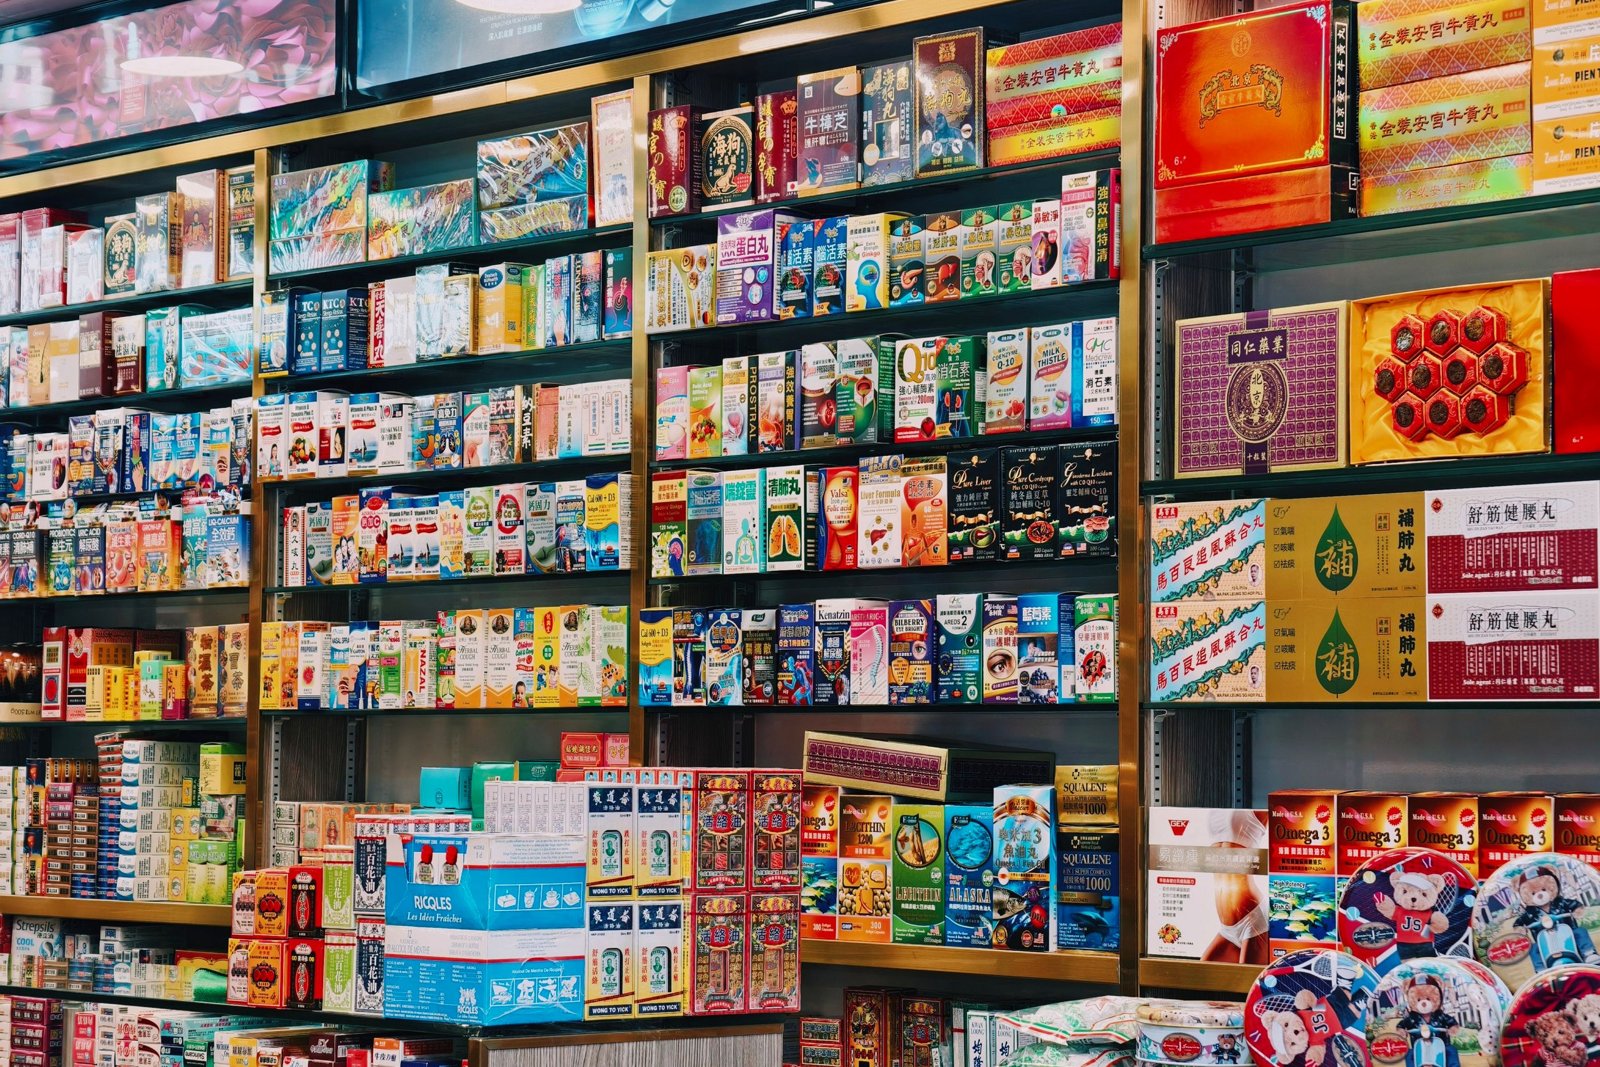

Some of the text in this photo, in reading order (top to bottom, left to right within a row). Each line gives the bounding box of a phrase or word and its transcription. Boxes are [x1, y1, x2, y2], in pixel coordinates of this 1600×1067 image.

[1379, 11, 1498, 49] 金裝安宮牛黃丸
[1003, 59, 1100, 92] 金裝安宮牛黃丸
[1379, 103, 1499, 139] 金裝安宮牛黃丸
[1042, 347, 1060, 358] MILK
[1231, 336, 1284, 357] 同仁藥業
[997, 357, 1015, 369] Q-10
[1037, 353, 1066, 368] THISTLE
[938, 361, 971, 379] 消石素
[1085, 376, 1112, 389] 消石素
[749, 366, 758, 441] PROSTRAL
[975, 476, 992, 486] Liver
[1468, 501, 1556, 525] 舒筋健腰丸
[1398, 508, 1416, 573] 補肺丸
[818, 609, 850, 620] Kenatzin
[894, 618, 925, 626] BILBERRY
[961, 616, 967, 625] 2
[1468, 610, 1557, 631] 舒筋健腰丸
[1398, 613, 1417, 678] 補肺丸
[419, 649, 427, 692] NAZAL
[1063, 782, 1107, 792] SQUALENE
[1084, 802, 1107, 815] 1000
[828, 813, 835, 827] 3
[857, 833, 874, 845] 1200
[1276, 824, 1330, 844] Omega 3
[1344, 826, 1402, 847] Omega 3
[1416, 828, 1475, 849] Omega 3
[1486, 828, 1546, 849] Omega 3
[1063, 853, 1111, 865] SQUALENE
[1086, 877, 1111, 891] 1000
[895, 887, 942, 902] LECITHIN
[949, 887, 992, 903] ALASKA
[414, 896, 452, 910] RICQLES
[407, 912, 419, 921] Les
[1402, 916, 1422, 931] JS
[16, 919, 55, 935] Strepsils
[17, 937, 35, 946] COOL
[457, 1005, 478, 1015] RICQLES
[1312, 1013, 1327, 1035] JS
